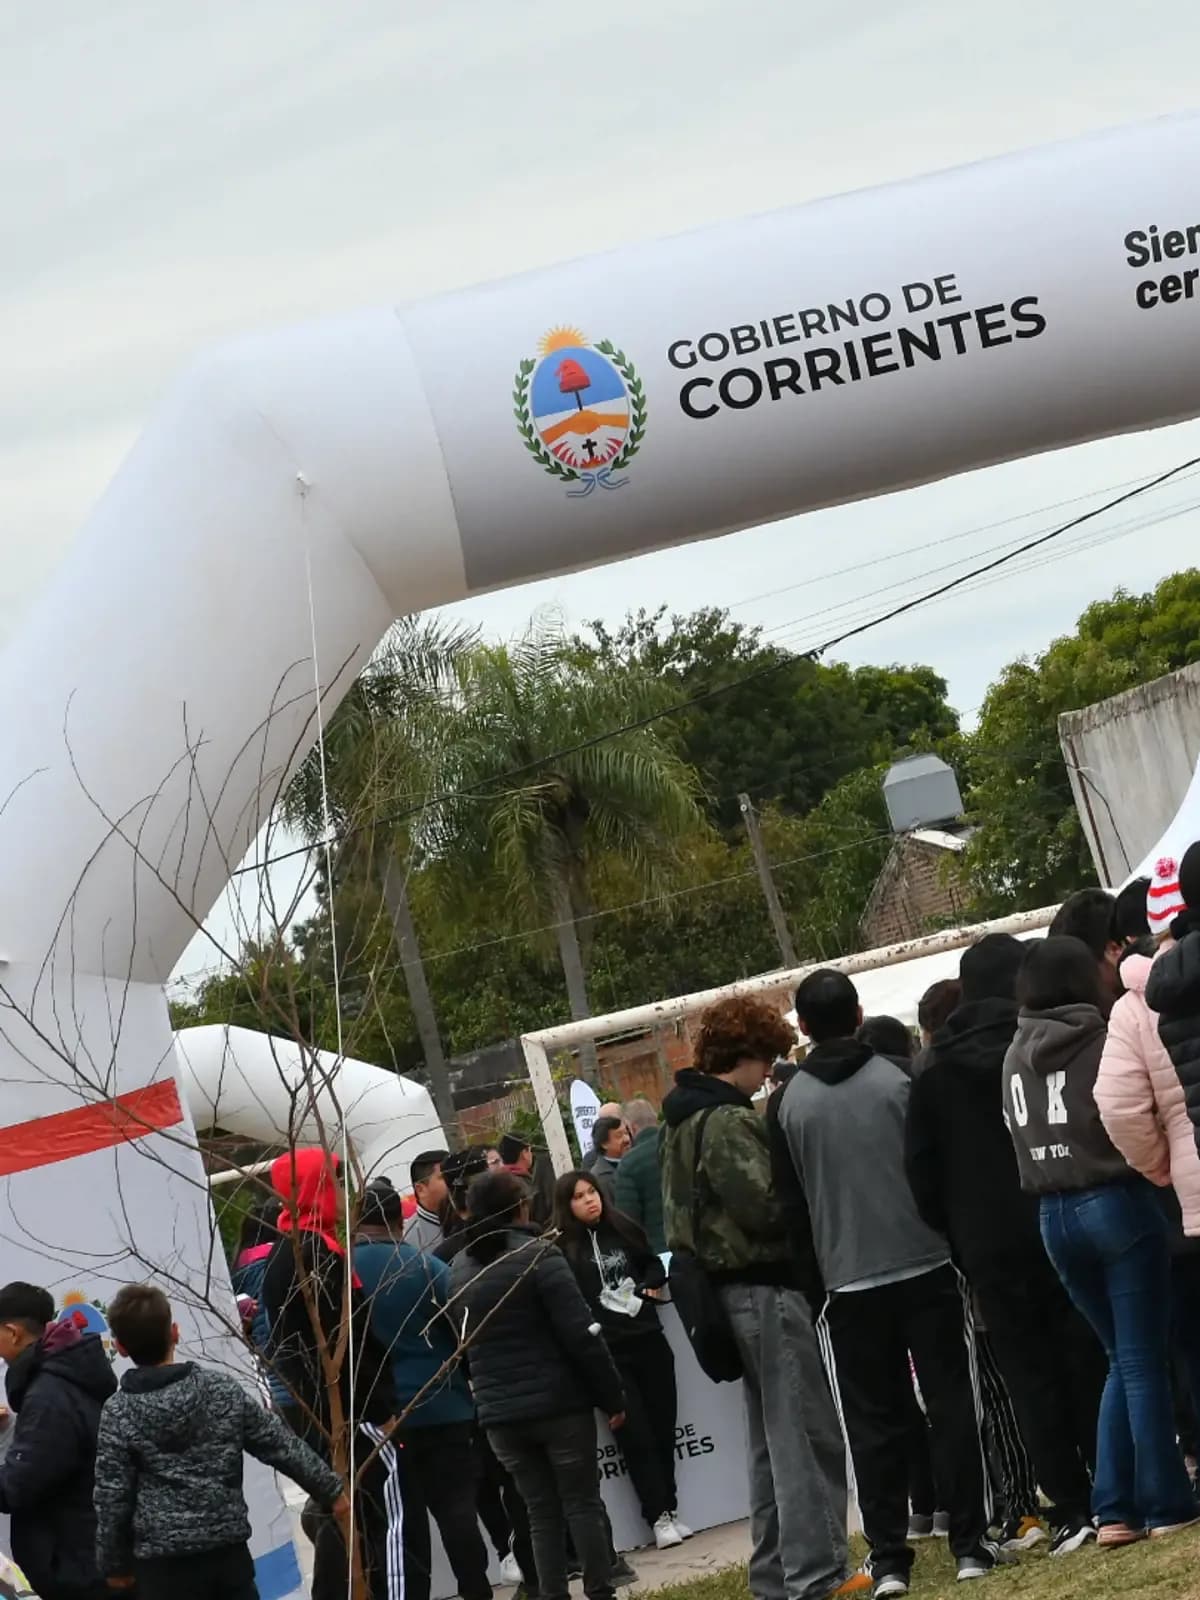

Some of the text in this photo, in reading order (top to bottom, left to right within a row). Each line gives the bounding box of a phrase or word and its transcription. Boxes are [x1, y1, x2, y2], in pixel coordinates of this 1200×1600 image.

[667, 273, 962, 369] GOBIERNO DE
[679, 296, 1047, 419] CORRIENTES
